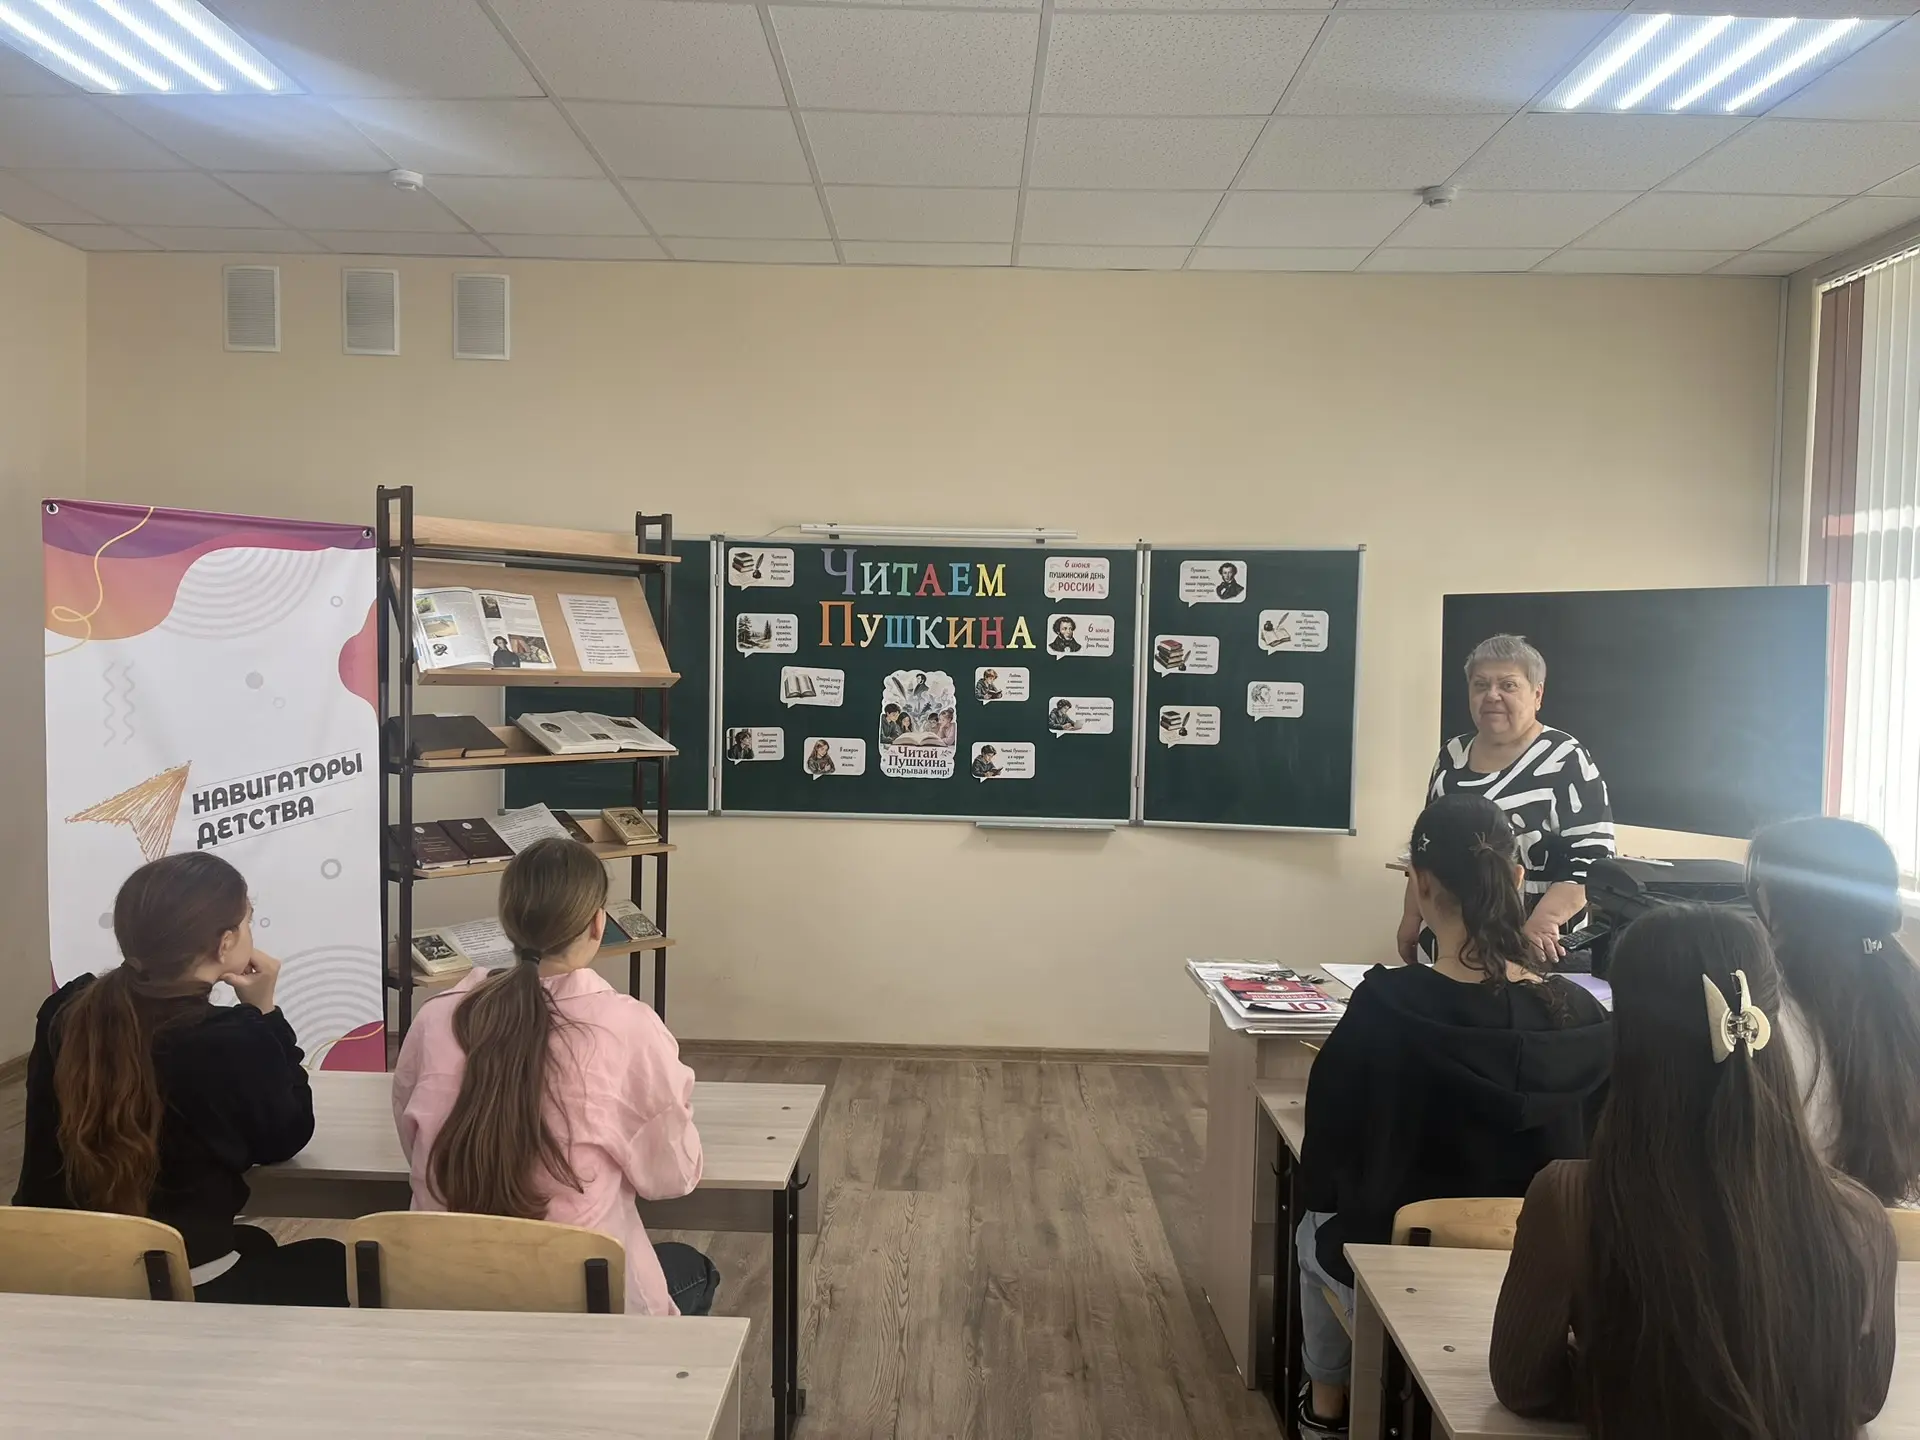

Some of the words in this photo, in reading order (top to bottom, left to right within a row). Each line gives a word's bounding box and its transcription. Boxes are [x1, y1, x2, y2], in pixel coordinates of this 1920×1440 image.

[1064, 560, 1070, 568] 6
[1049, 571, 1089, 579] ПУШКИНСКИЙ
[1058, 582, 1095, 592] РОССИИ
[1088, 623, 1094, 633] 6
[898, 747, 938, 759] Читай
[886, 767, 929, 776] открывай
[930, 768, 950, 777] мир!
[192, 753, 363, 815] НАВИГАТОРЫ
[197, 796, 315, 849] ДЕТСТВА
